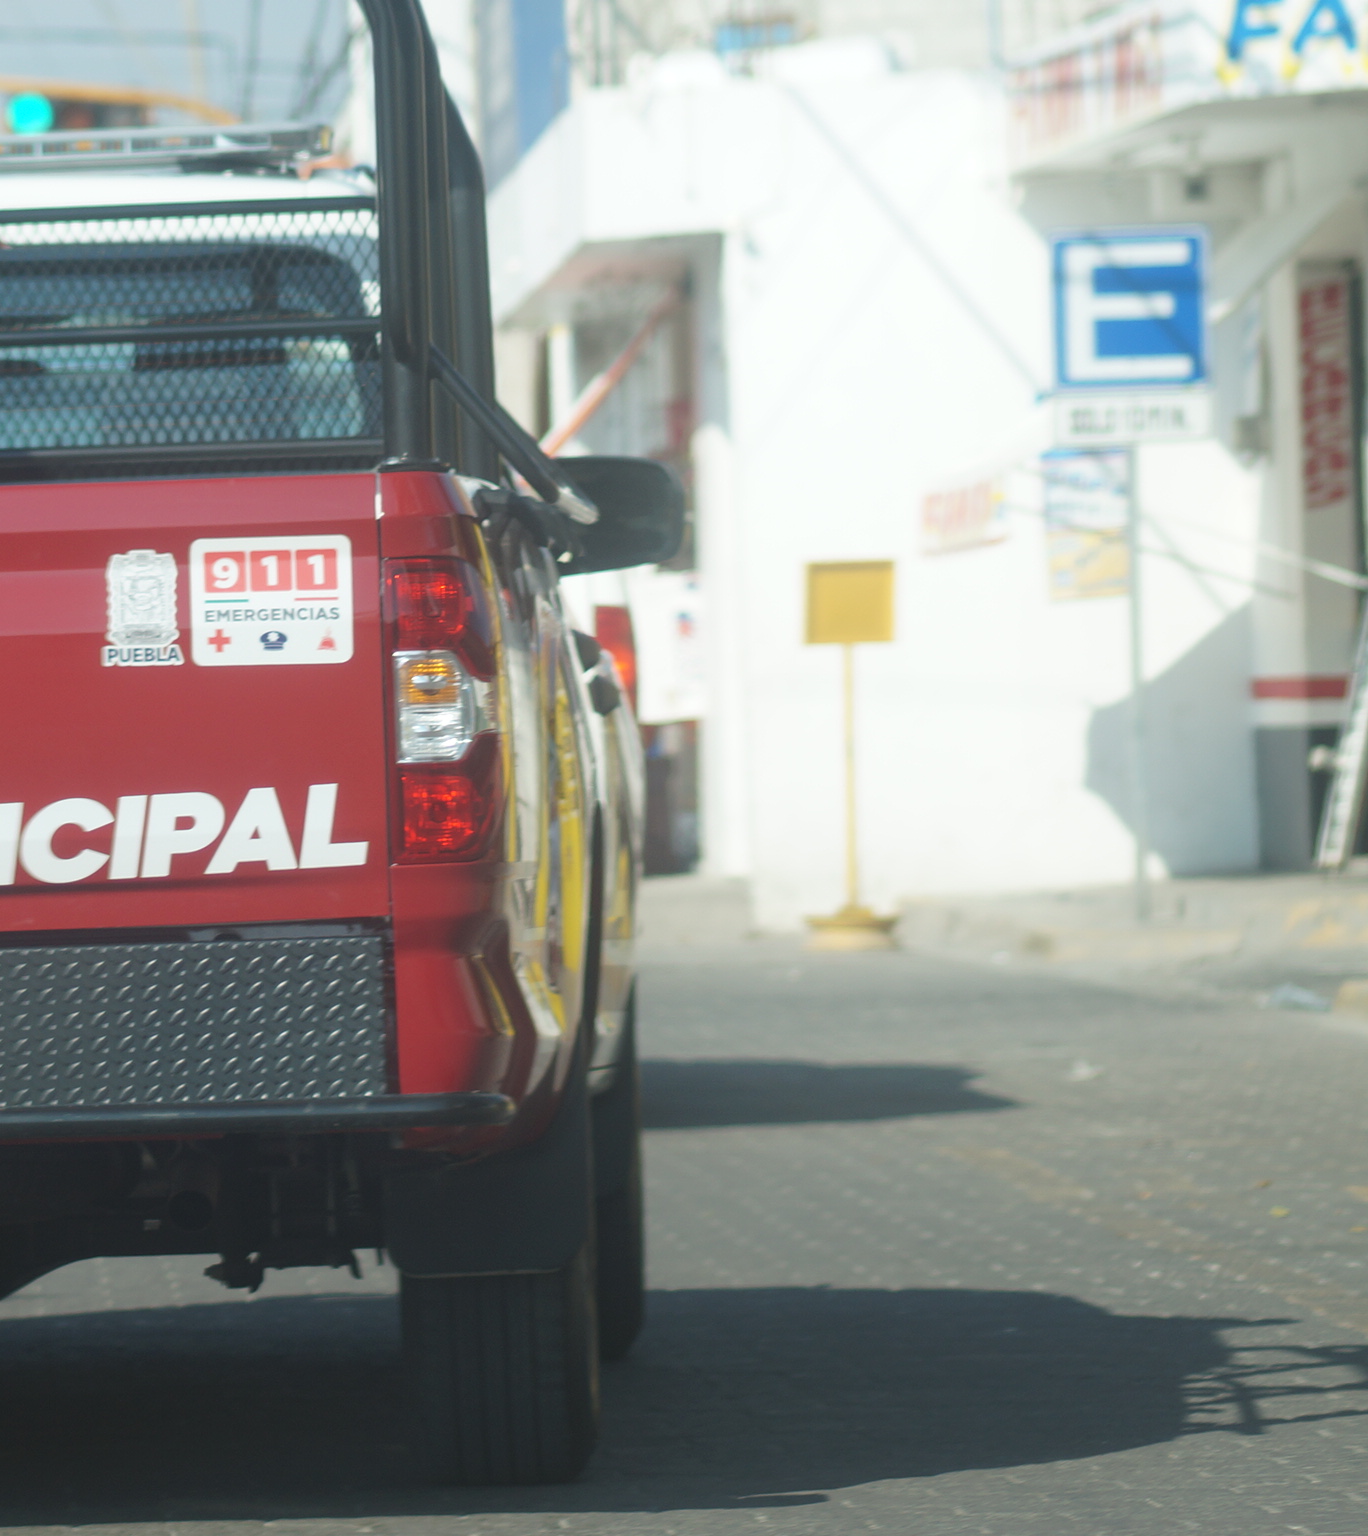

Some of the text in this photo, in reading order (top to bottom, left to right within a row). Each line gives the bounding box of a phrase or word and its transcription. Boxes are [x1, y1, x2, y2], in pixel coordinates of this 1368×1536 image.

[1063, 241, 1194, 382] E
[212, 553, 325, 589] 911
[204, 607, 341, 623] EMERGENCIAS
[106, 646, 181, 663] PUEBLA
